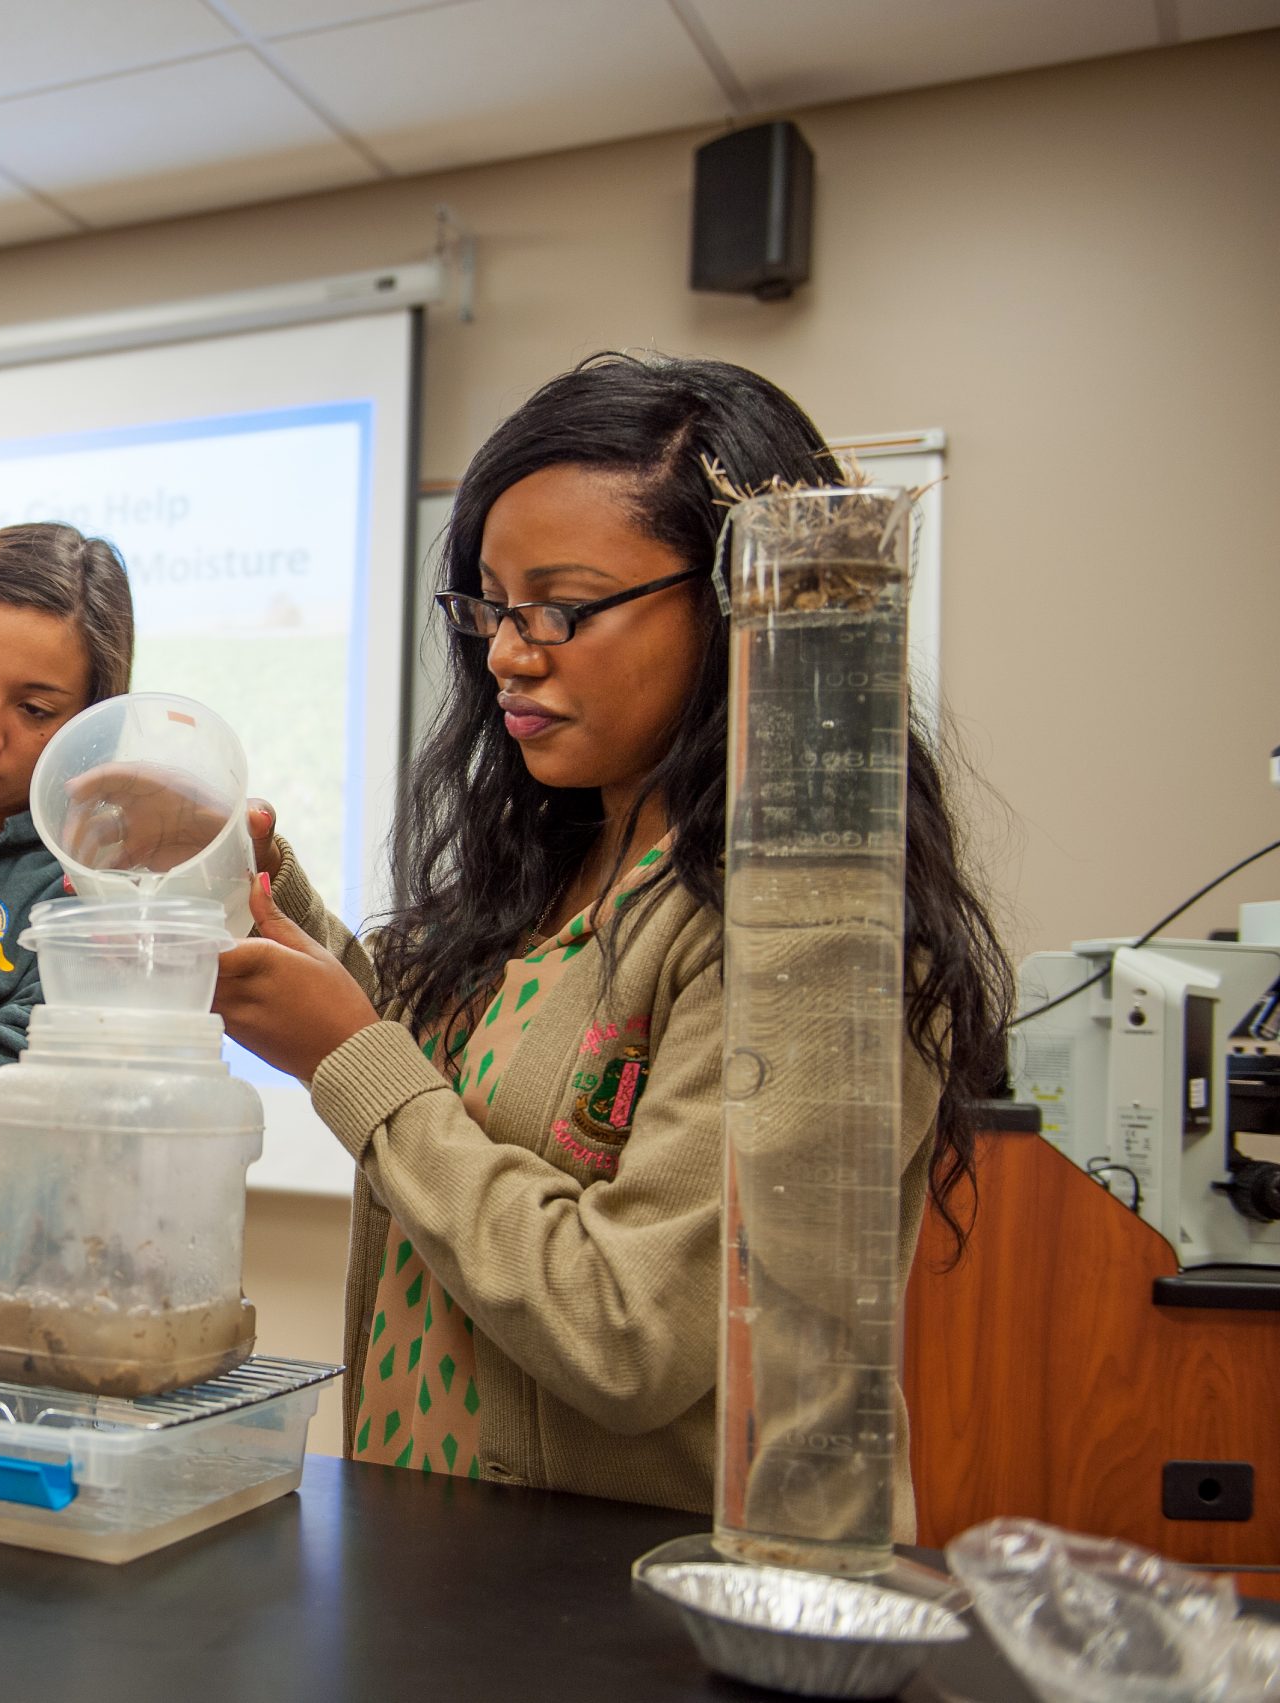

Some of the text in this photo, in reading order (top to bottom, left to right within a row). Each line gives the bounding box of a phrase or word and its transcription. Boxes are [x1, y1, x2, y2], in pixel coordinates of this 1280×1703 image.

[103, 485, 191, 528] Help
[130, 545, 312, 584] Moisture
[572, 1071, 599, 1092] 19
